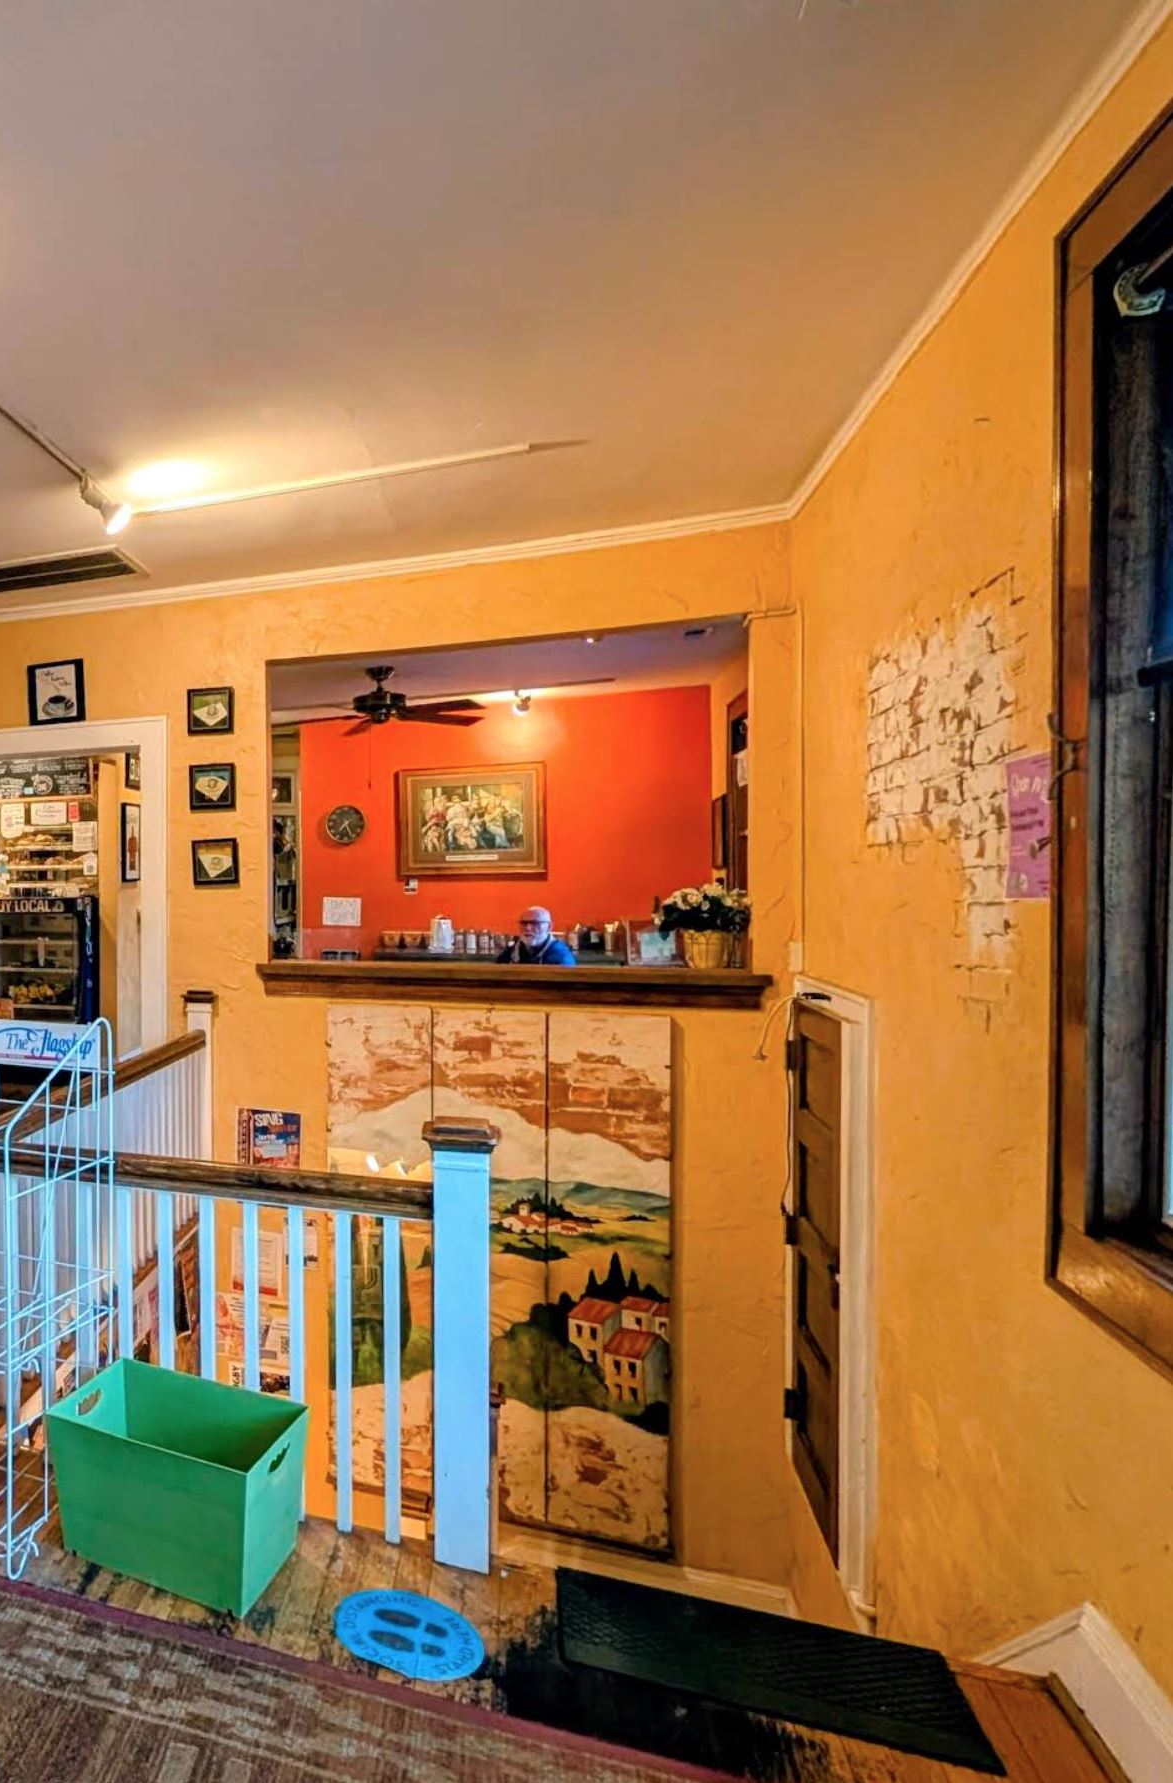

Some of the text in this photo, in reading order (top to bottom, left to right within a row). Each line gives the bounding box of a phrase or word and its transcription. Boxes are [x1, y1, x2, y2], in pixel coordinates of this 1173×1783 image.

[14, 900, 52, 913] LOCAL
[7, 1033, 29, 1051] The
[254, 1112, 284, 1127] SING
[342, 1594, 420, 1670] SOCIAL DISTANCING
[434, 1615, 475, 1675] STAND HERE
